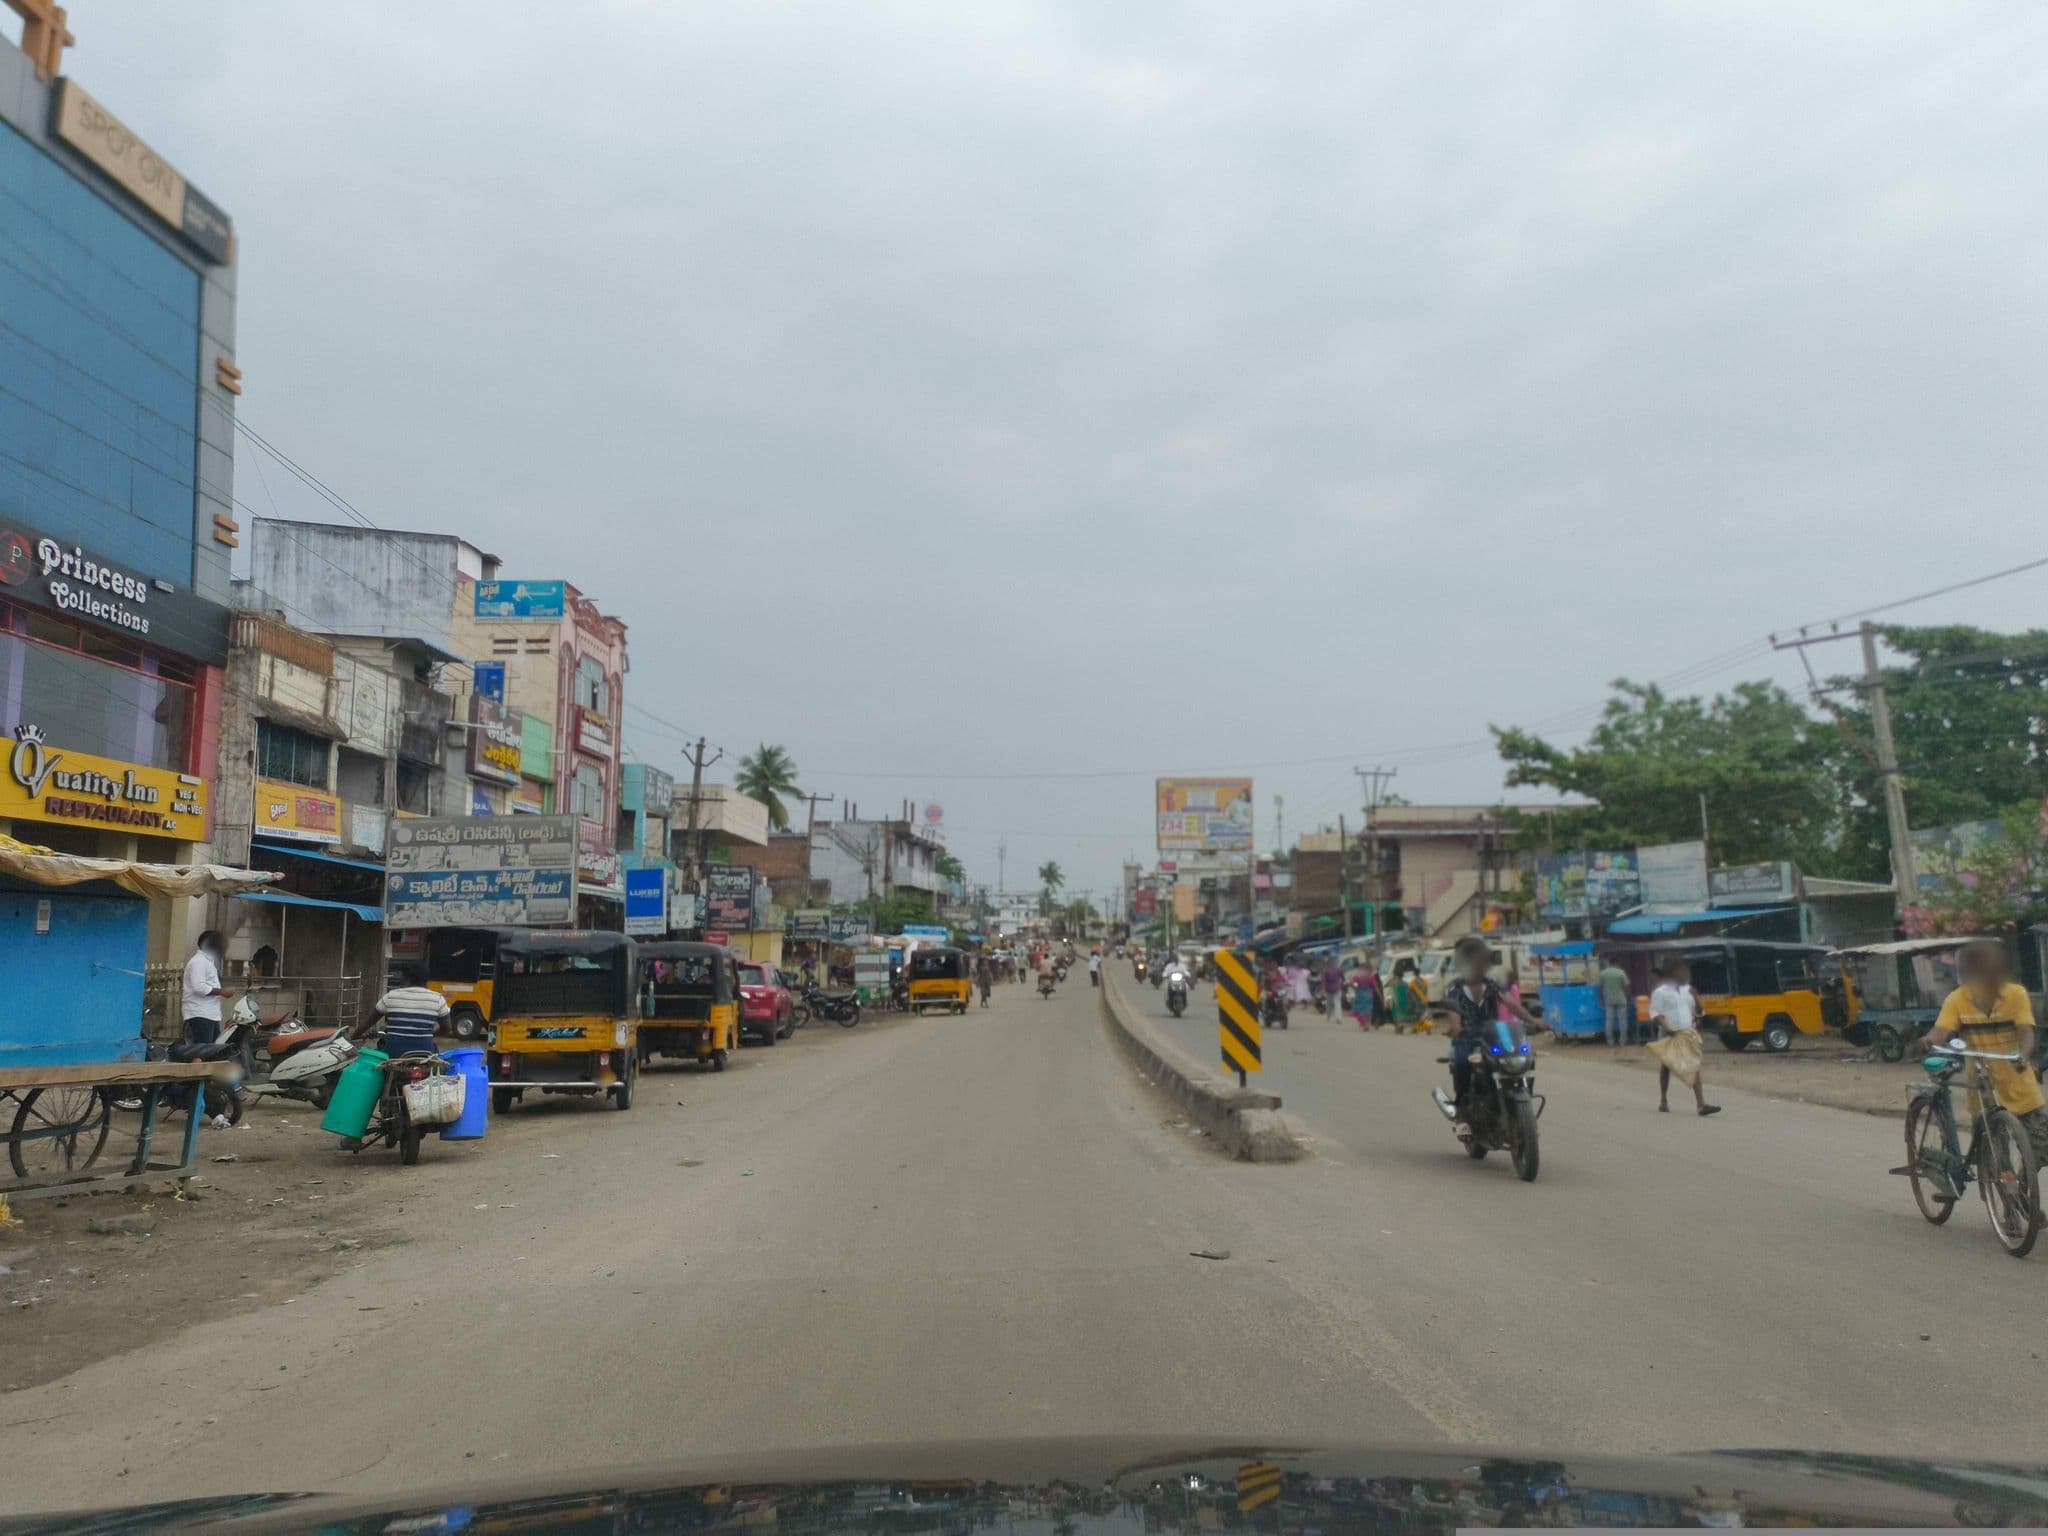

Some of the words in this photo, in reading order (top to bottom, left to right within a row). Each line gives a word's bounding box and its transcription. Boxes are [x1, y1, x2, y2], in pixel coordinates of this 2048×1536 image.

[80, 100, 137, 164] SPOT
[139, 153, 174, 199] ON
[38, 538, 147, 603] Princess
[50, 581, 149, 634] Collections
[126, 770, 158, 803] Inn
[179, 788, 192, 800] VEG
[45, 797, 164, 827] RESTAURANT
